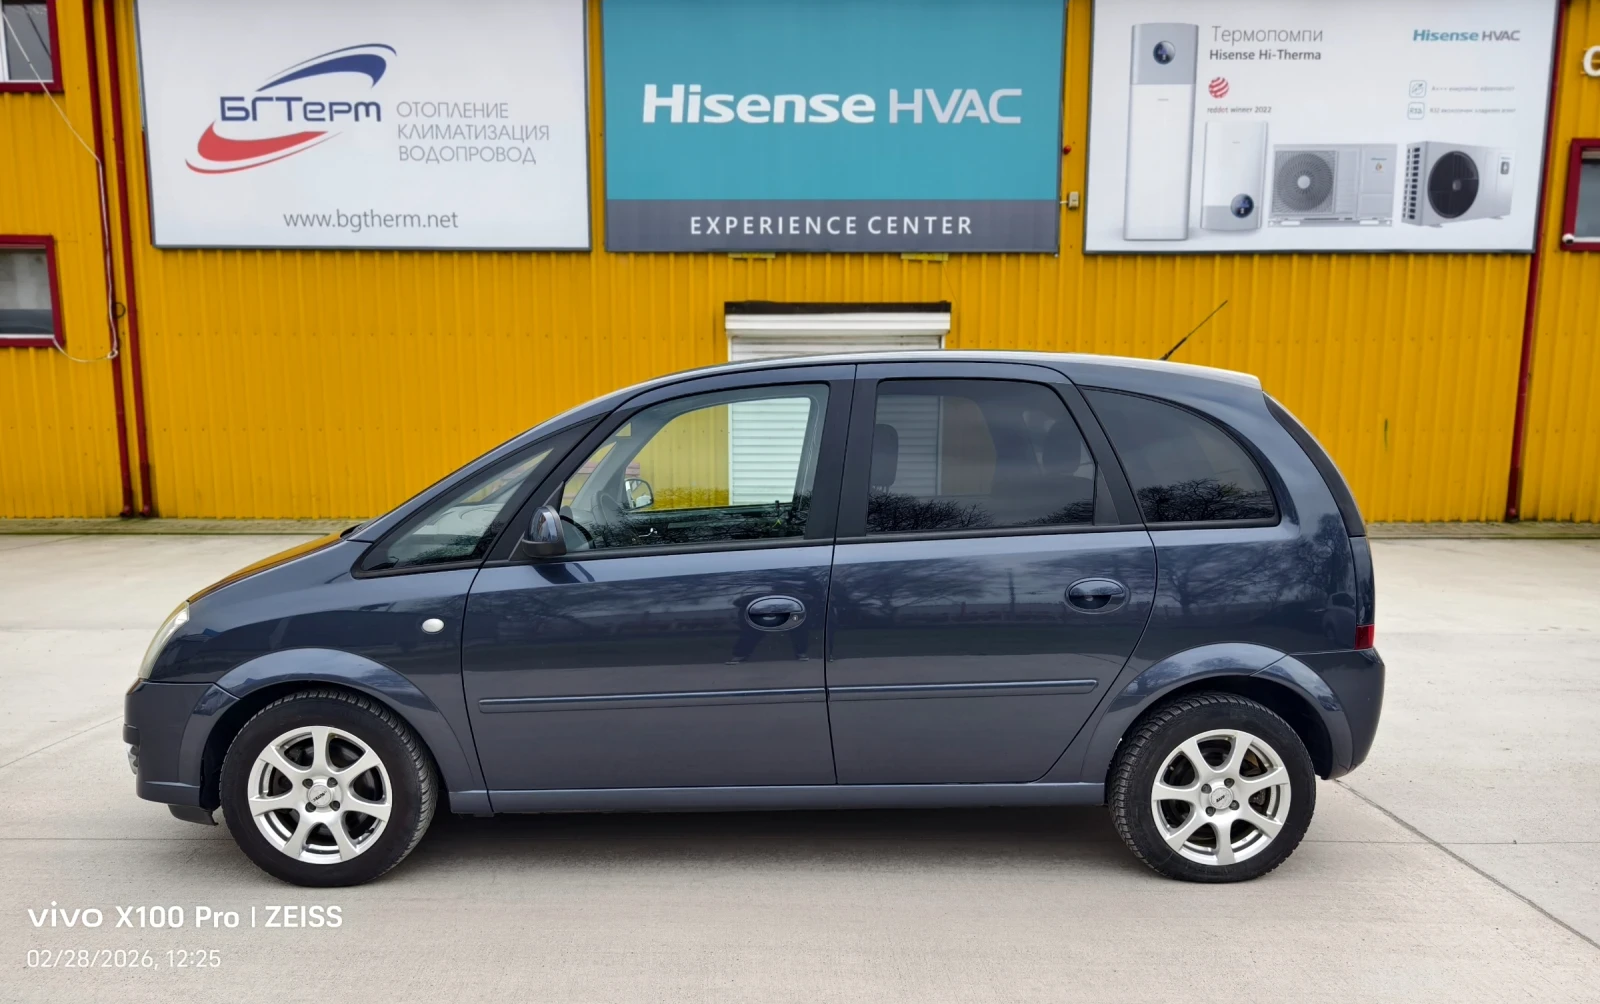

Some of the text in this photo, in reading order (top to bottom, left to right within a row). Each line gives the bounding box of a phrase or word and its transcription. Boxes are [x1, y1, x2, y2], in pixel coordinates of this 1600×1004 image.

[1211, 25, 1323, 47] Термопомпи
[1412, 29, 1521, 42] Hisense HVAC
[1209, 49, 1322, 61] Hisense Hi-Therma
[396, 101, 510, 119] ОТОПЛЕНИЕ
[642, 83, 1022, 124] Hisense HVAC
[1230, 106, 1253, 114] winner
[1254, 105, 1273, 114] 2022
[397, 123, 550, 144] КЛИМАТИЗАЦИЯ
[398, 145, 537, 165] ВОДОПРОВОД
[282, 208, 460, 234] www.bgtherm.net
[690, 215, 973, 235] EXPERIENCE CENTER
